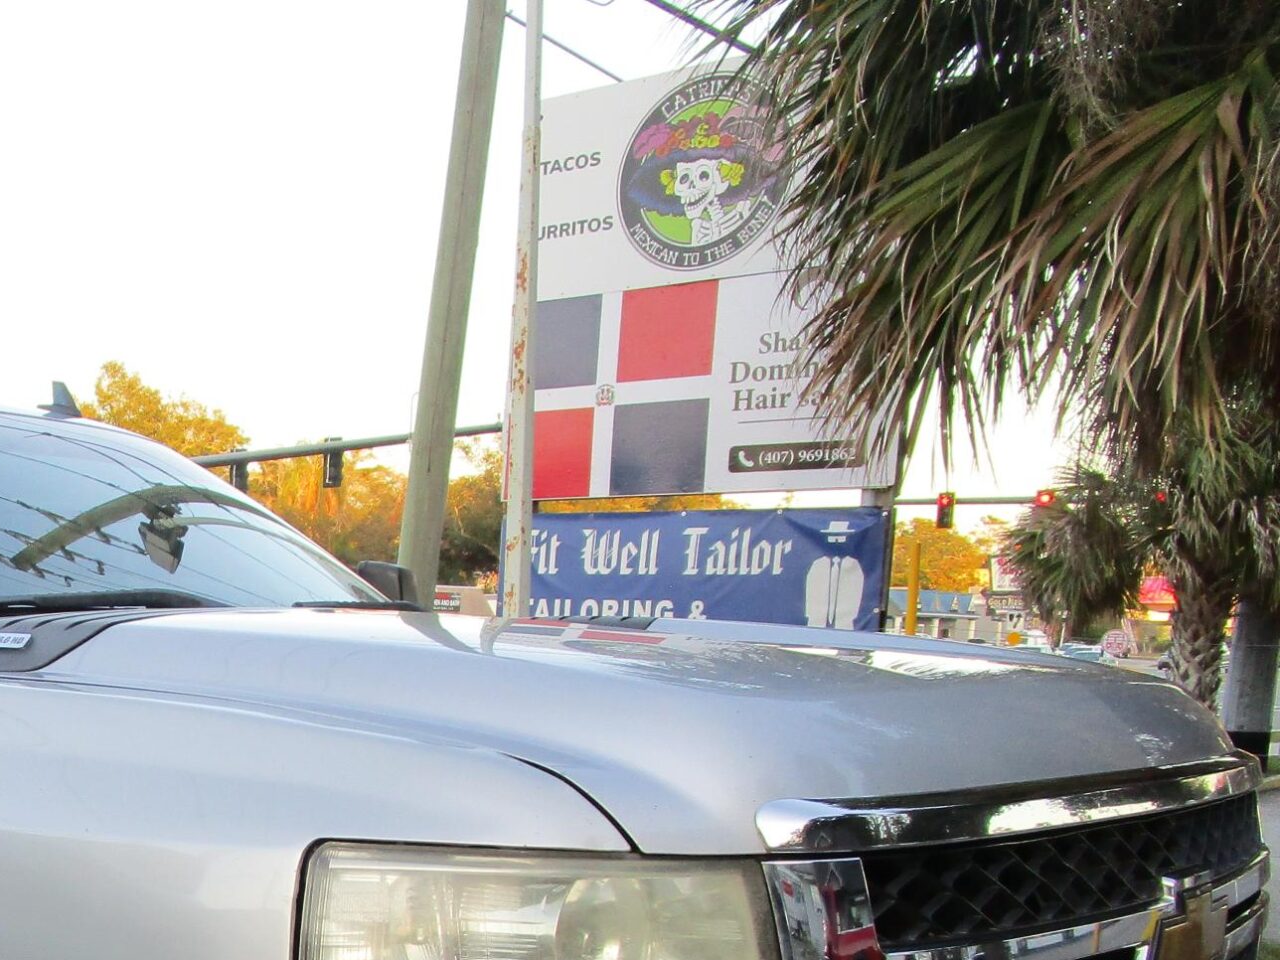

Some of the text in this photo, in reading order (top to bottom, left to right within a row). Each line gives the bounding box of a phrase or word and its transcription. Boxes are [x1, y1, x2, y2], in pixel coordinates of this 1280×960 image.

[540, 151, 601, 175] TACOS
[538, 215, 614, 241] URRITOS
[630, 222, 679, 265] MEXICAN
[683, 252, 700, 266] TO
[704, 238, 737, 262] THE
[732, 387, 792, 411] Hair
[758, 449, 794, 467] (407)
[581, 528, 664, 575] Well
[682, 526, 793, 576] Tailor
[530, 598, 707, 619] AILORING &
